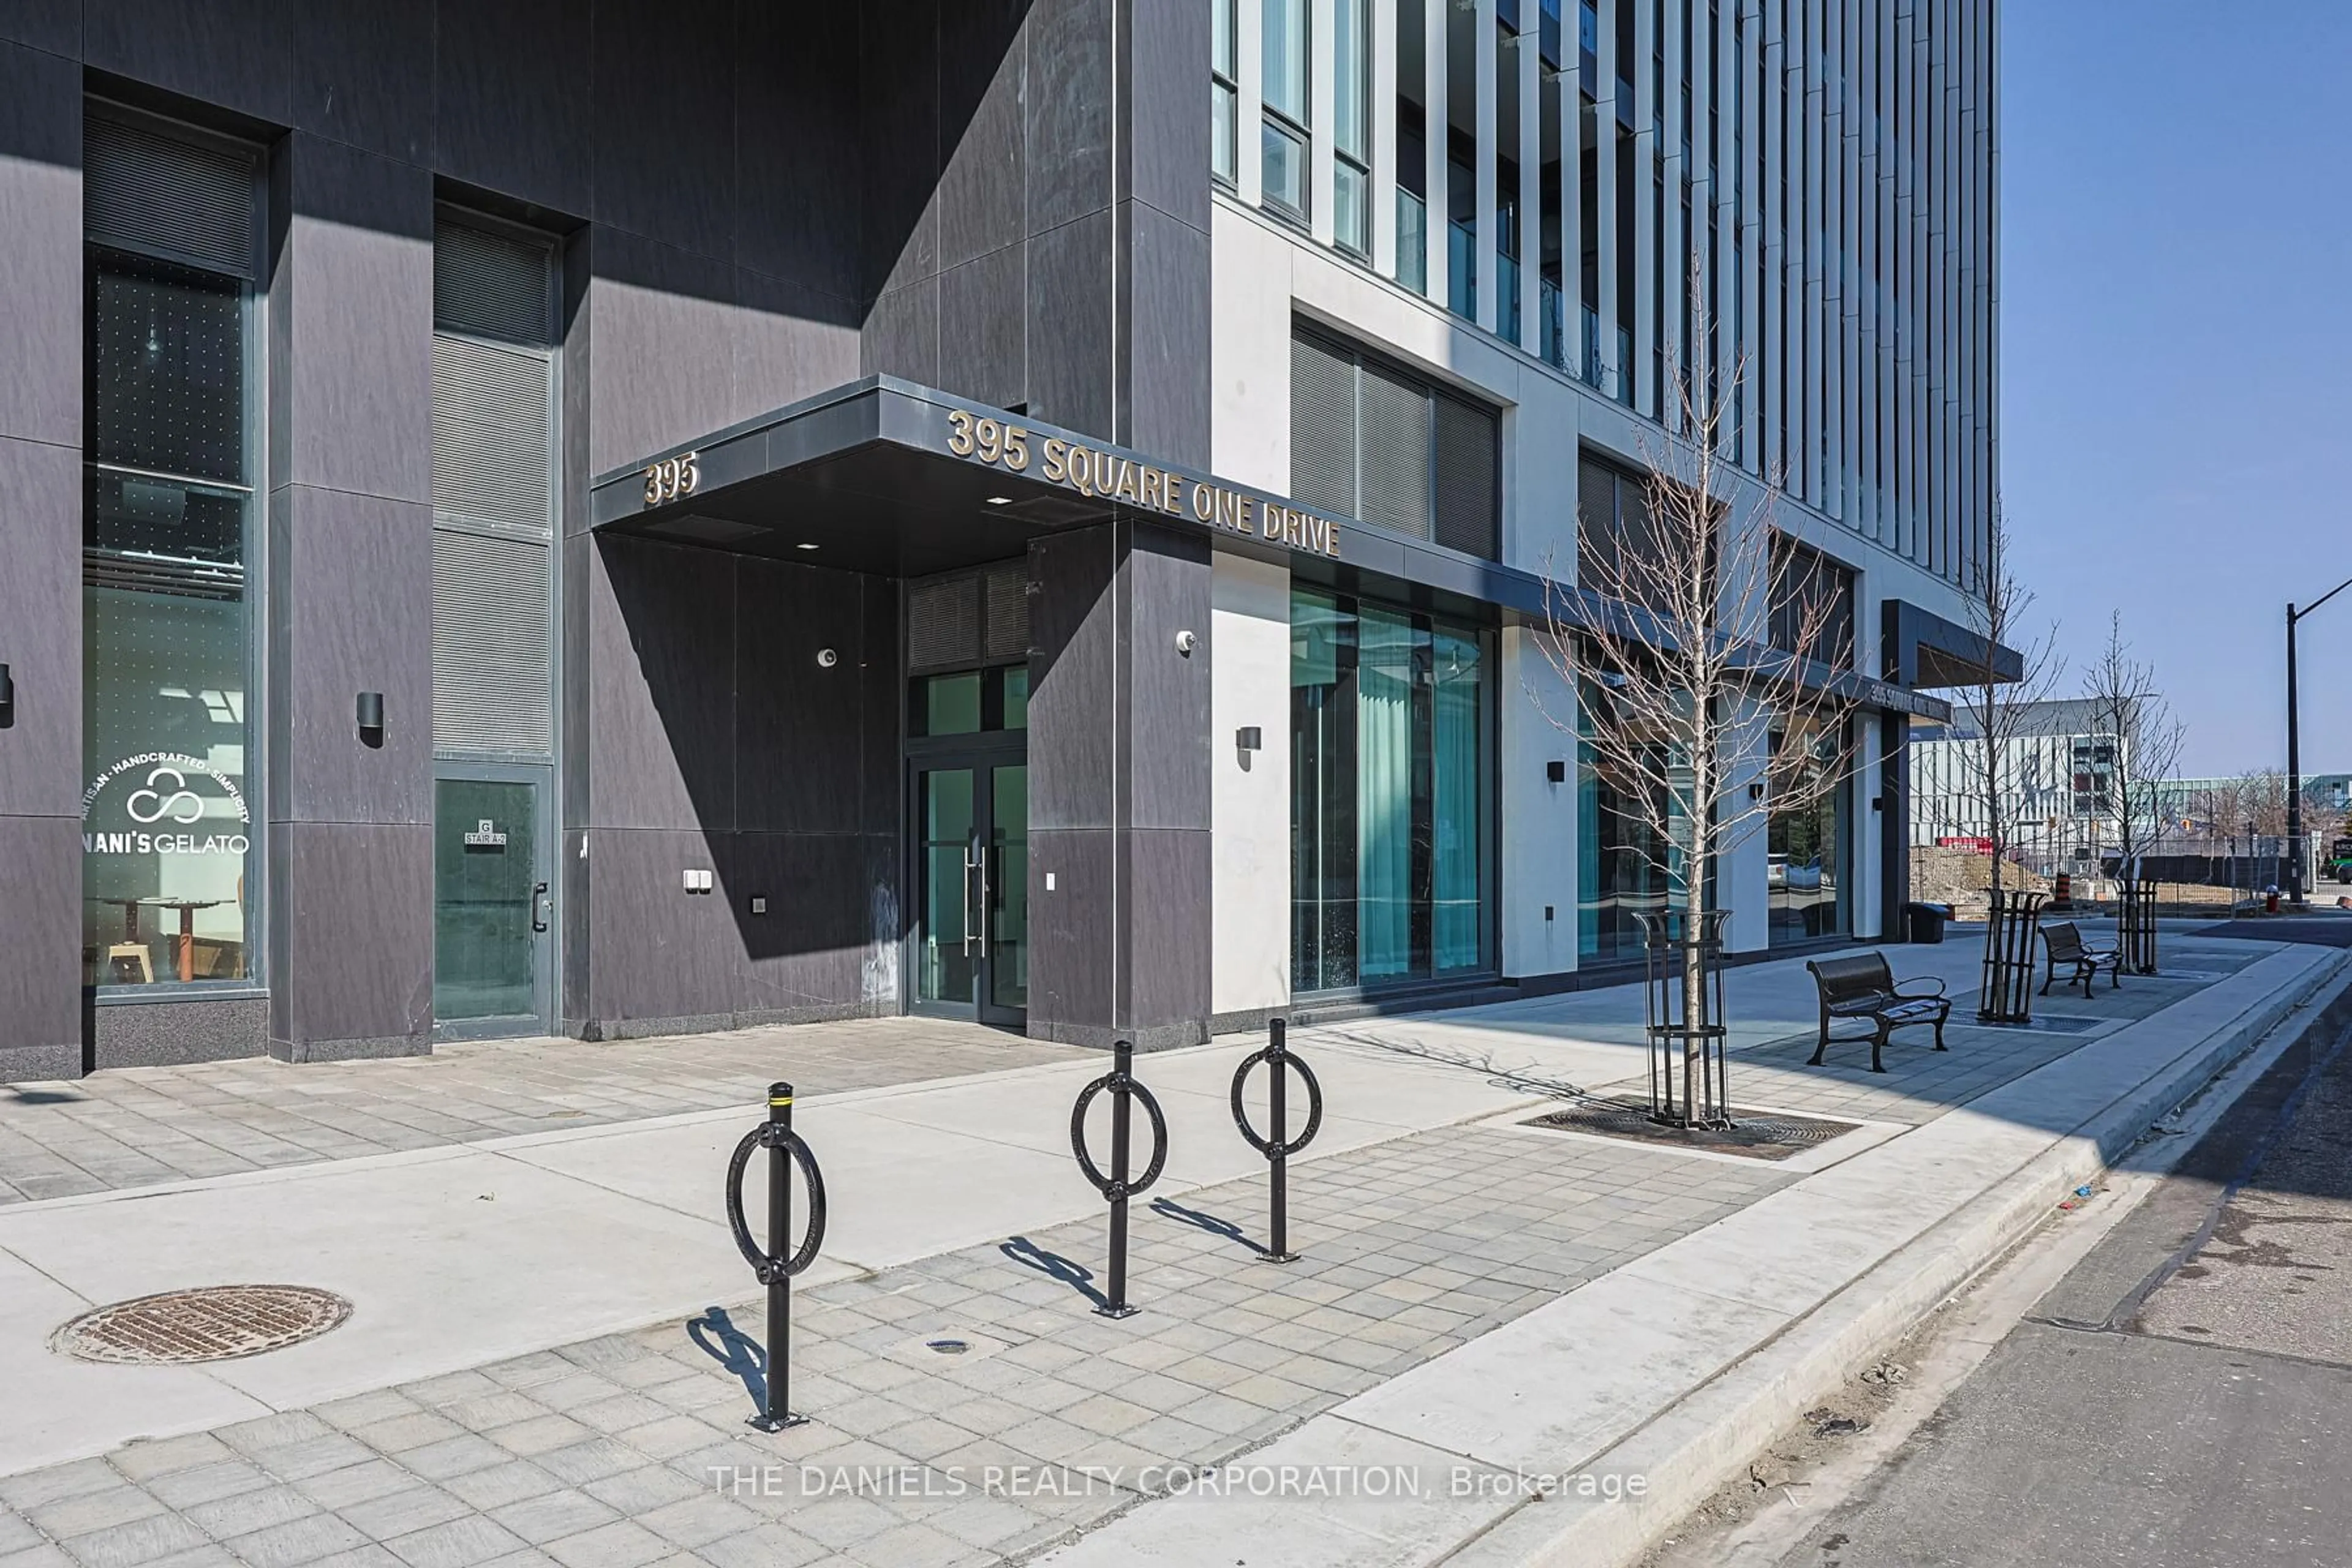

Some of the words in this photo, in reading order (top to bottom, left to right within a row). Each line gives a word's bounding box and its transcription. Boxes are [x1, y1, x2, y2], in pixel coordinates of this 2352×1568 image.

[644, 451, 699, 504] 395
[948, 410, 1030, 470] 395
[1042, 438, 1182, 513] SQUARE
[1193, 483, 1253, 533] ONE
[1263, 501, 1341, 557] DRIVE
[111, 752, 206, 775] HANDCRAFTED
[210, 769, 251, 824] SIMPLICITY
[466, 835, 489, 843] STAIR
[481, 823, 490, 832] G
